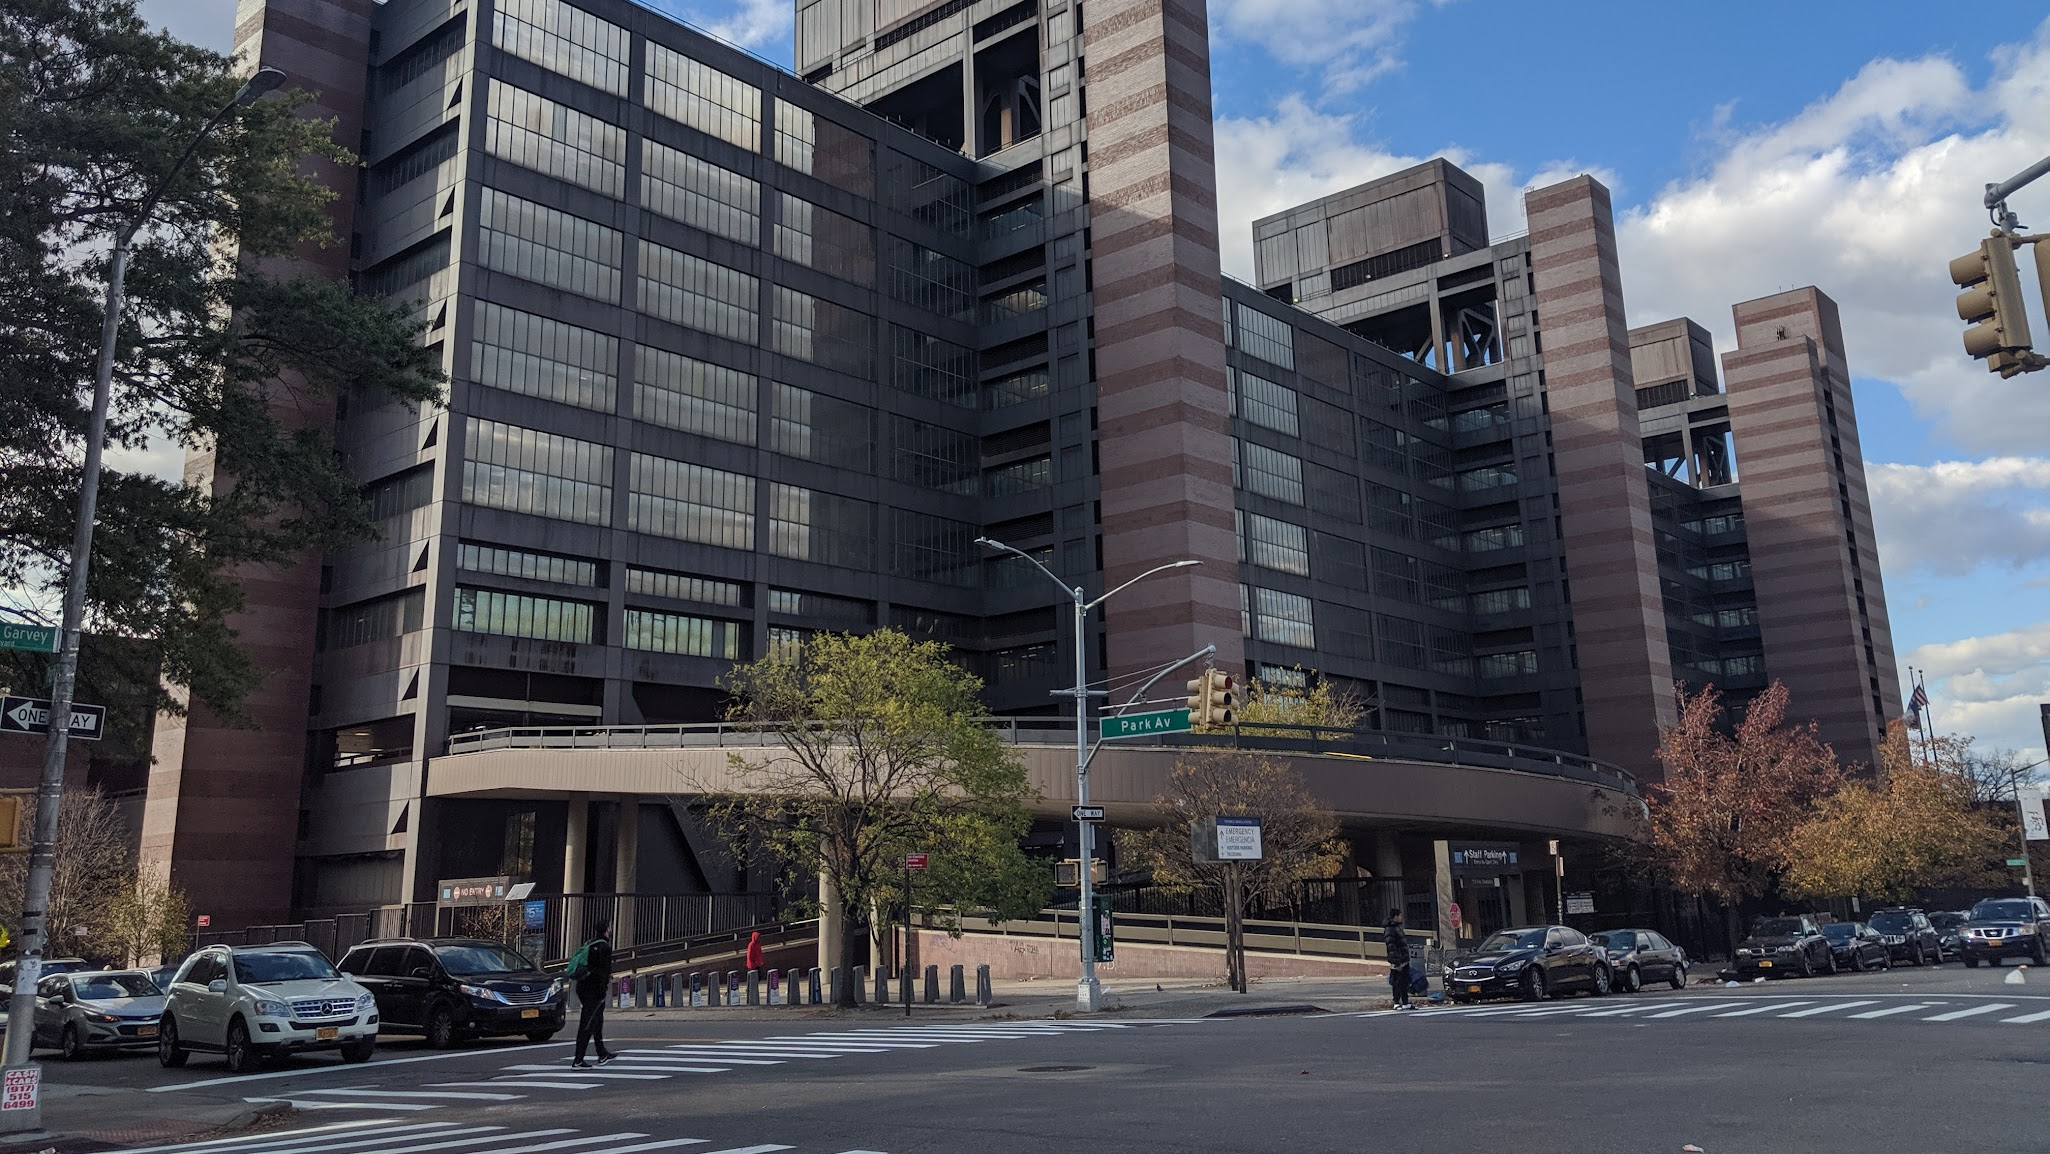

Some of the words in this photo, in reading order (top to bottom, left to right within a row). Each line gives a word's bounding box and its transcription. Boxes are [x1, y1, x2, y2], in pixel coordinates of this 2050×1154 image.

[4, 625, 48, 645] Garvey
[18, 708, 47, 724] ONE
[1121, 718, 1152, 732] Park
[1155, 716, 1171, 729] Av
[1468, 849, 1483, 859] Staff
[1483, 850, 1503, 860] Parking
[461, 888, 469, 896] NO
[469, 887, 485, 896] ENTRY
[7, 1070, 38, 1078] CASH
[7, 1084, 35, 1093] (917)
[9, 1093, 31, 1101] 515
[3, 1100, 35, 1109] 6499
